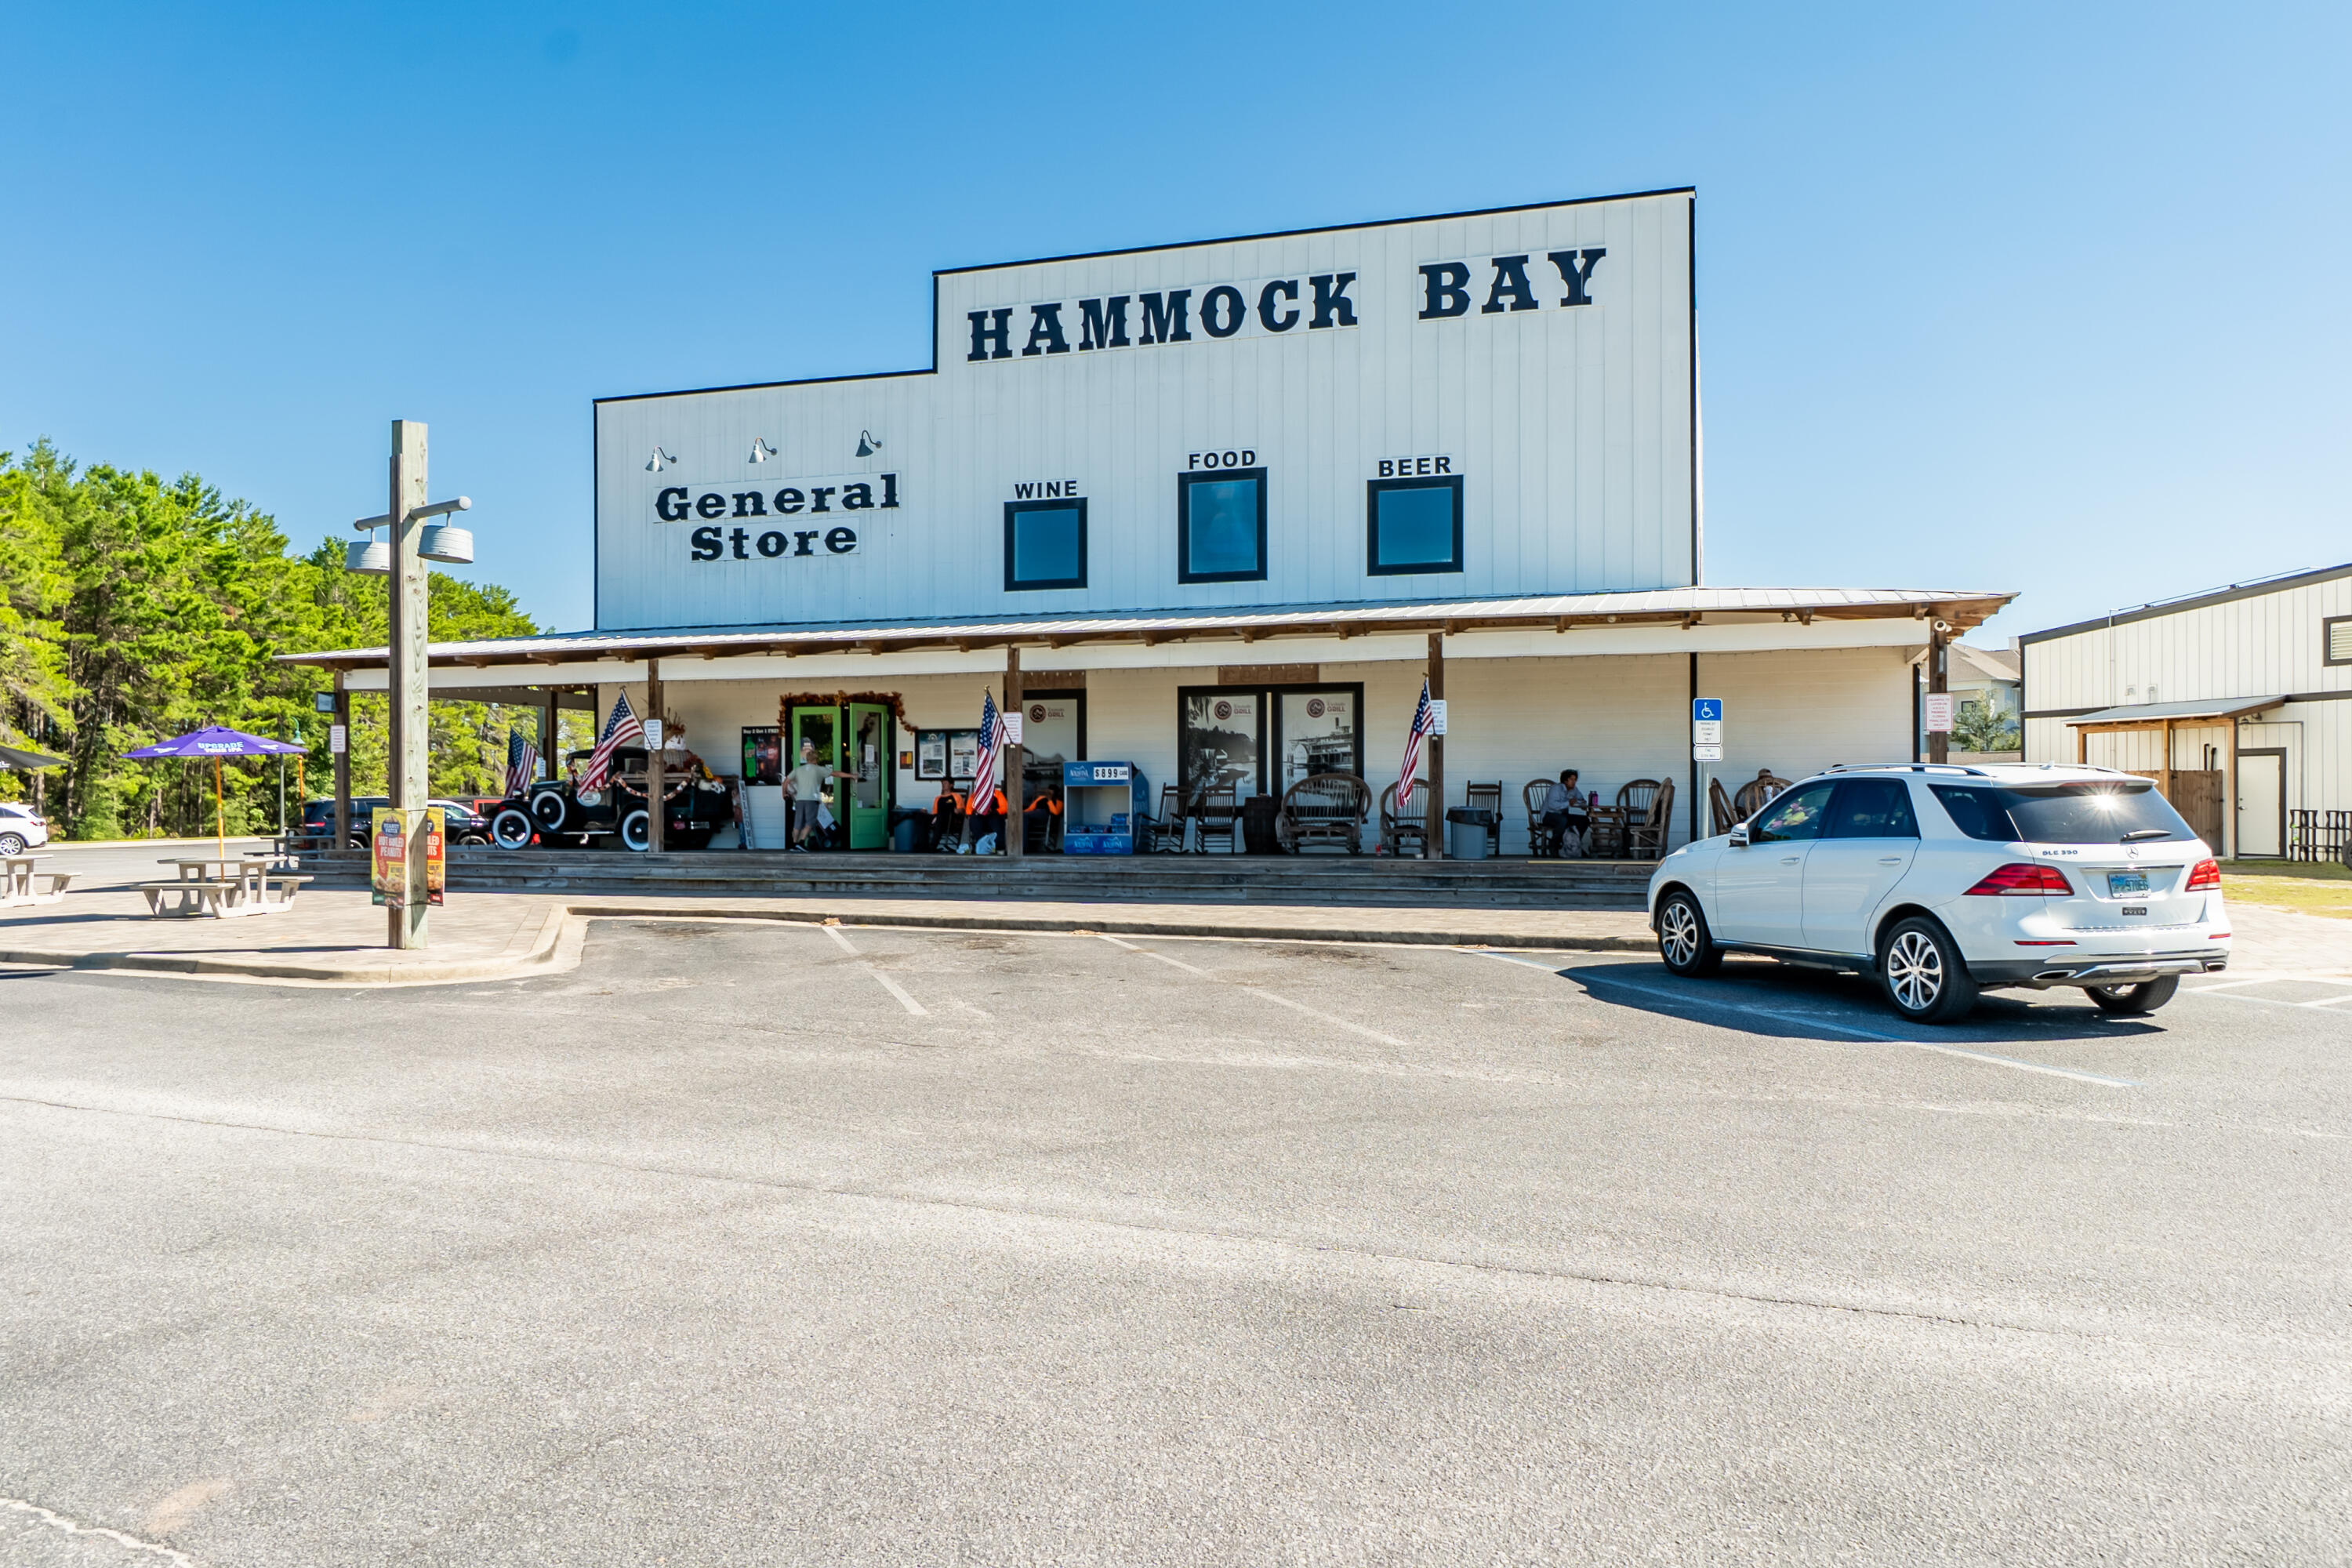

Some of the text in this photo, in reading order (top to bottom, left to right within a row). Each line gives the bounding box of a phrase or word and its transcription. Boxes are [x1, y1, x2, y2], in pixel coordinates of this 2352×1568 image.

[967, 248, 1606, 361] HAMMOCK BAY
[1189, 450, 1256, 470] FOOD
[1378, 456, 1451, 477] BEER
[655, 473, 899, 521] General
[1014, 481, 1077, 499] WINE
[691, 526, 857, 561] Store
[378, 836, 405, 848] HOT BOILED
[380, 847, 402, 858] PEANUTS
